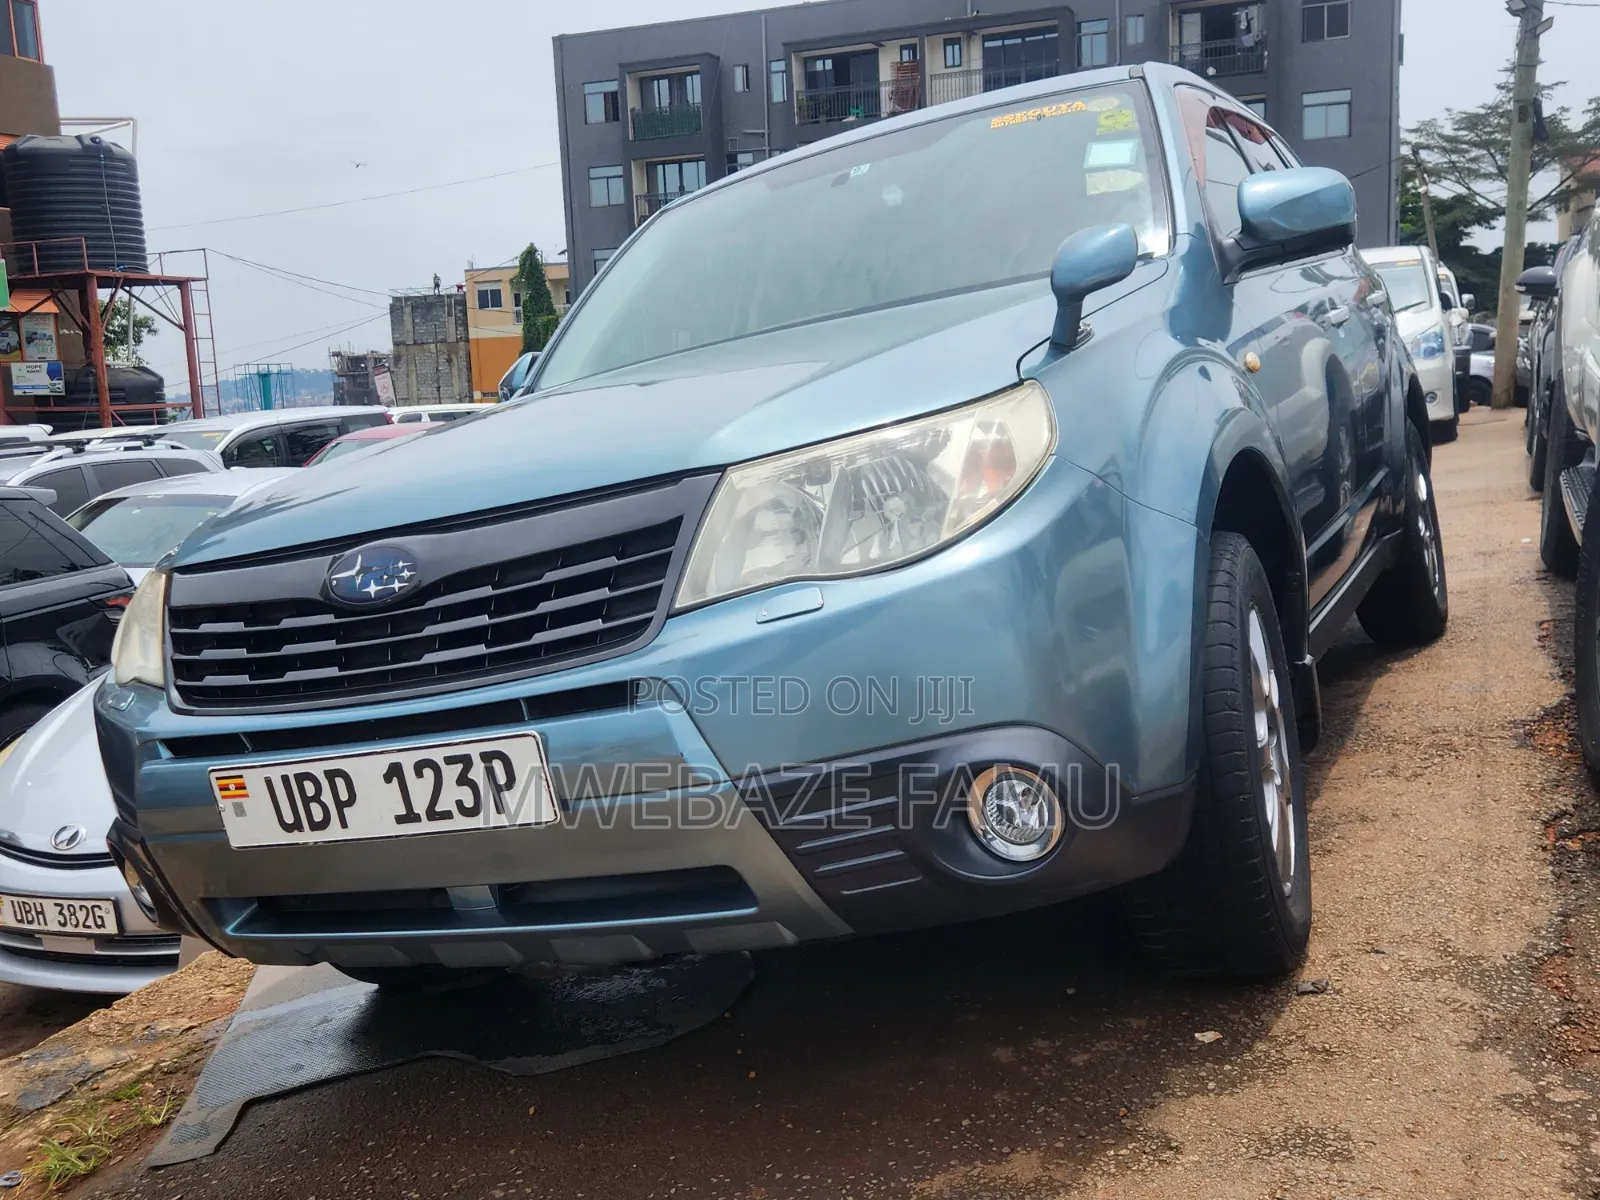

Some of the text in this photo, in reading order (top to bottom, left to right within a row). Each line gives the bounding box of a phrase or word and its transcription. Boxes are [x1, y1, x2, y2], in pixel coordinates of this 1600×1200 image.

[264, 750, 517, 834] UBP 123P
[10, 899, 107, 930] UBH 382G
